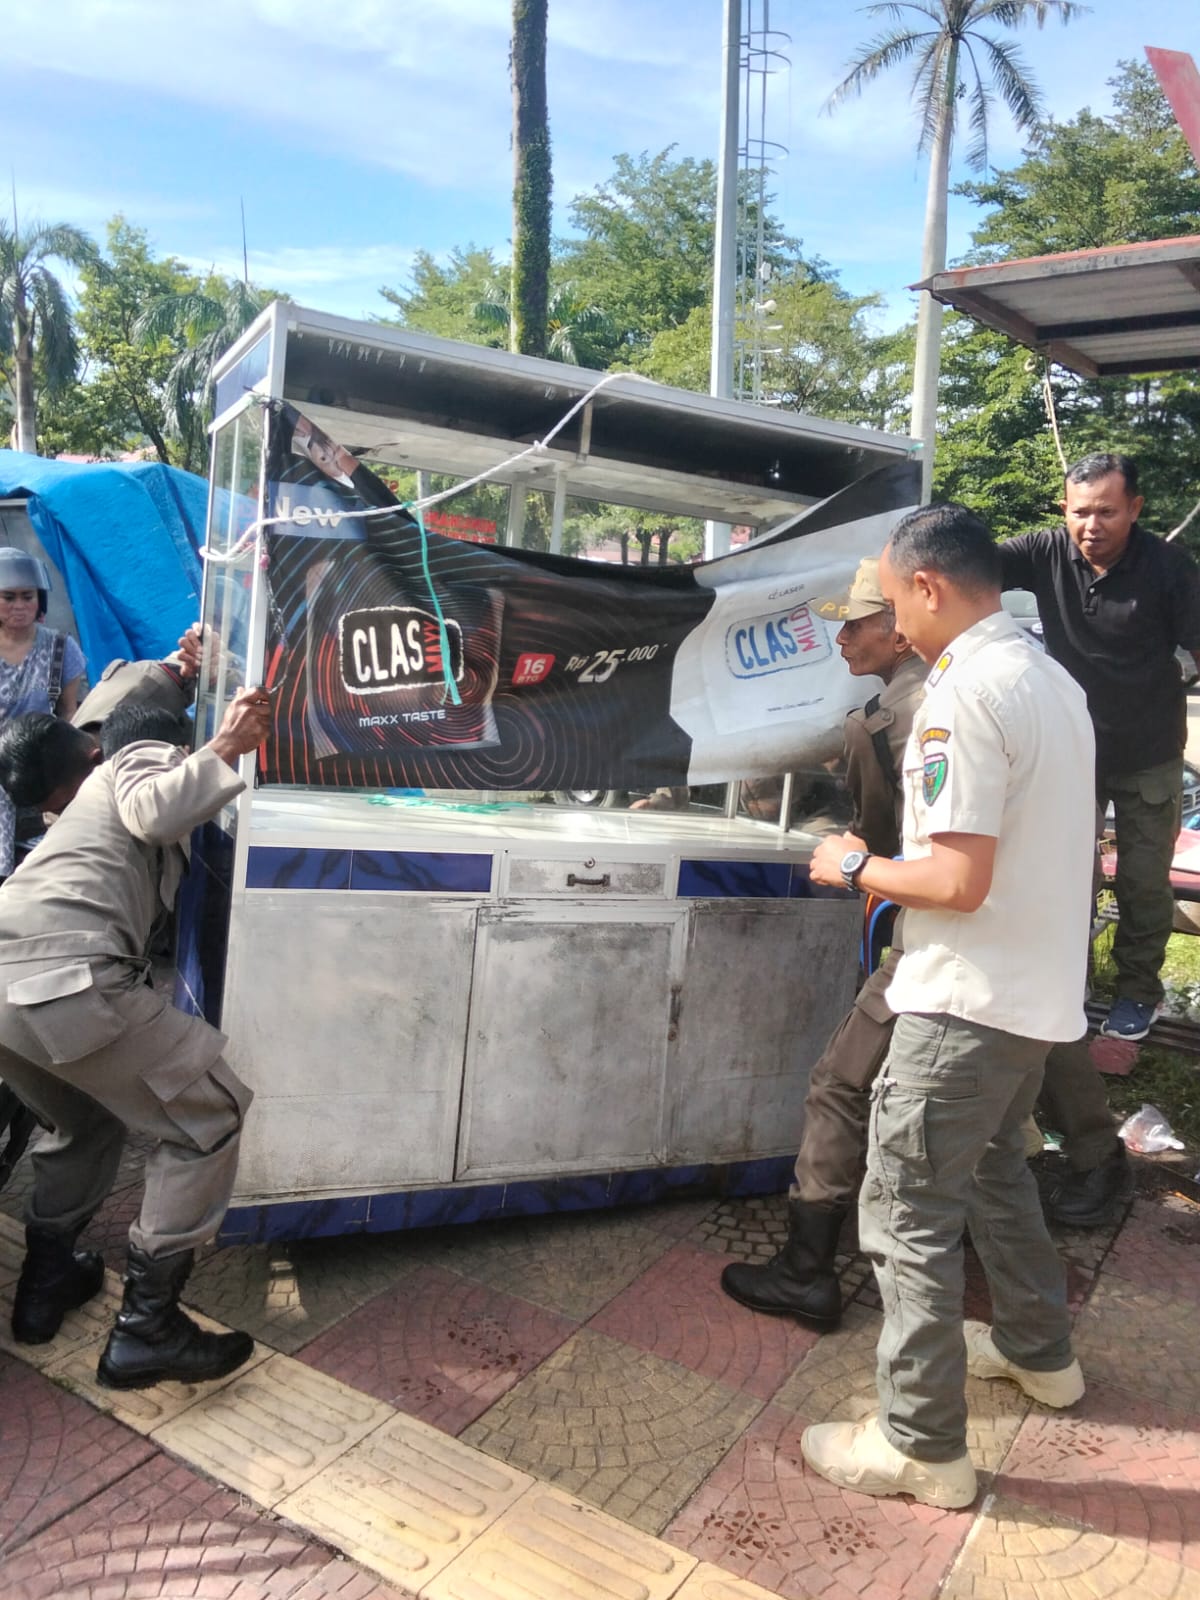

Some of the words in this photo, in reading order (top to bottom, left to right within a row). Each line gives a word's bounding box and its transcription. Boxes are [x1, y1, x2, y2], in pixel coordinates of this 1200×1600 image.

[352, 619, 424, 683] CLAS
[734, 616, 798, 670] CLAS
[789, 606, 823, 652] MILD
[523, 658, 547, 676] 16
[359, 714, 399, 728] MAXX
[402, 708, 447, 722] TASTE
